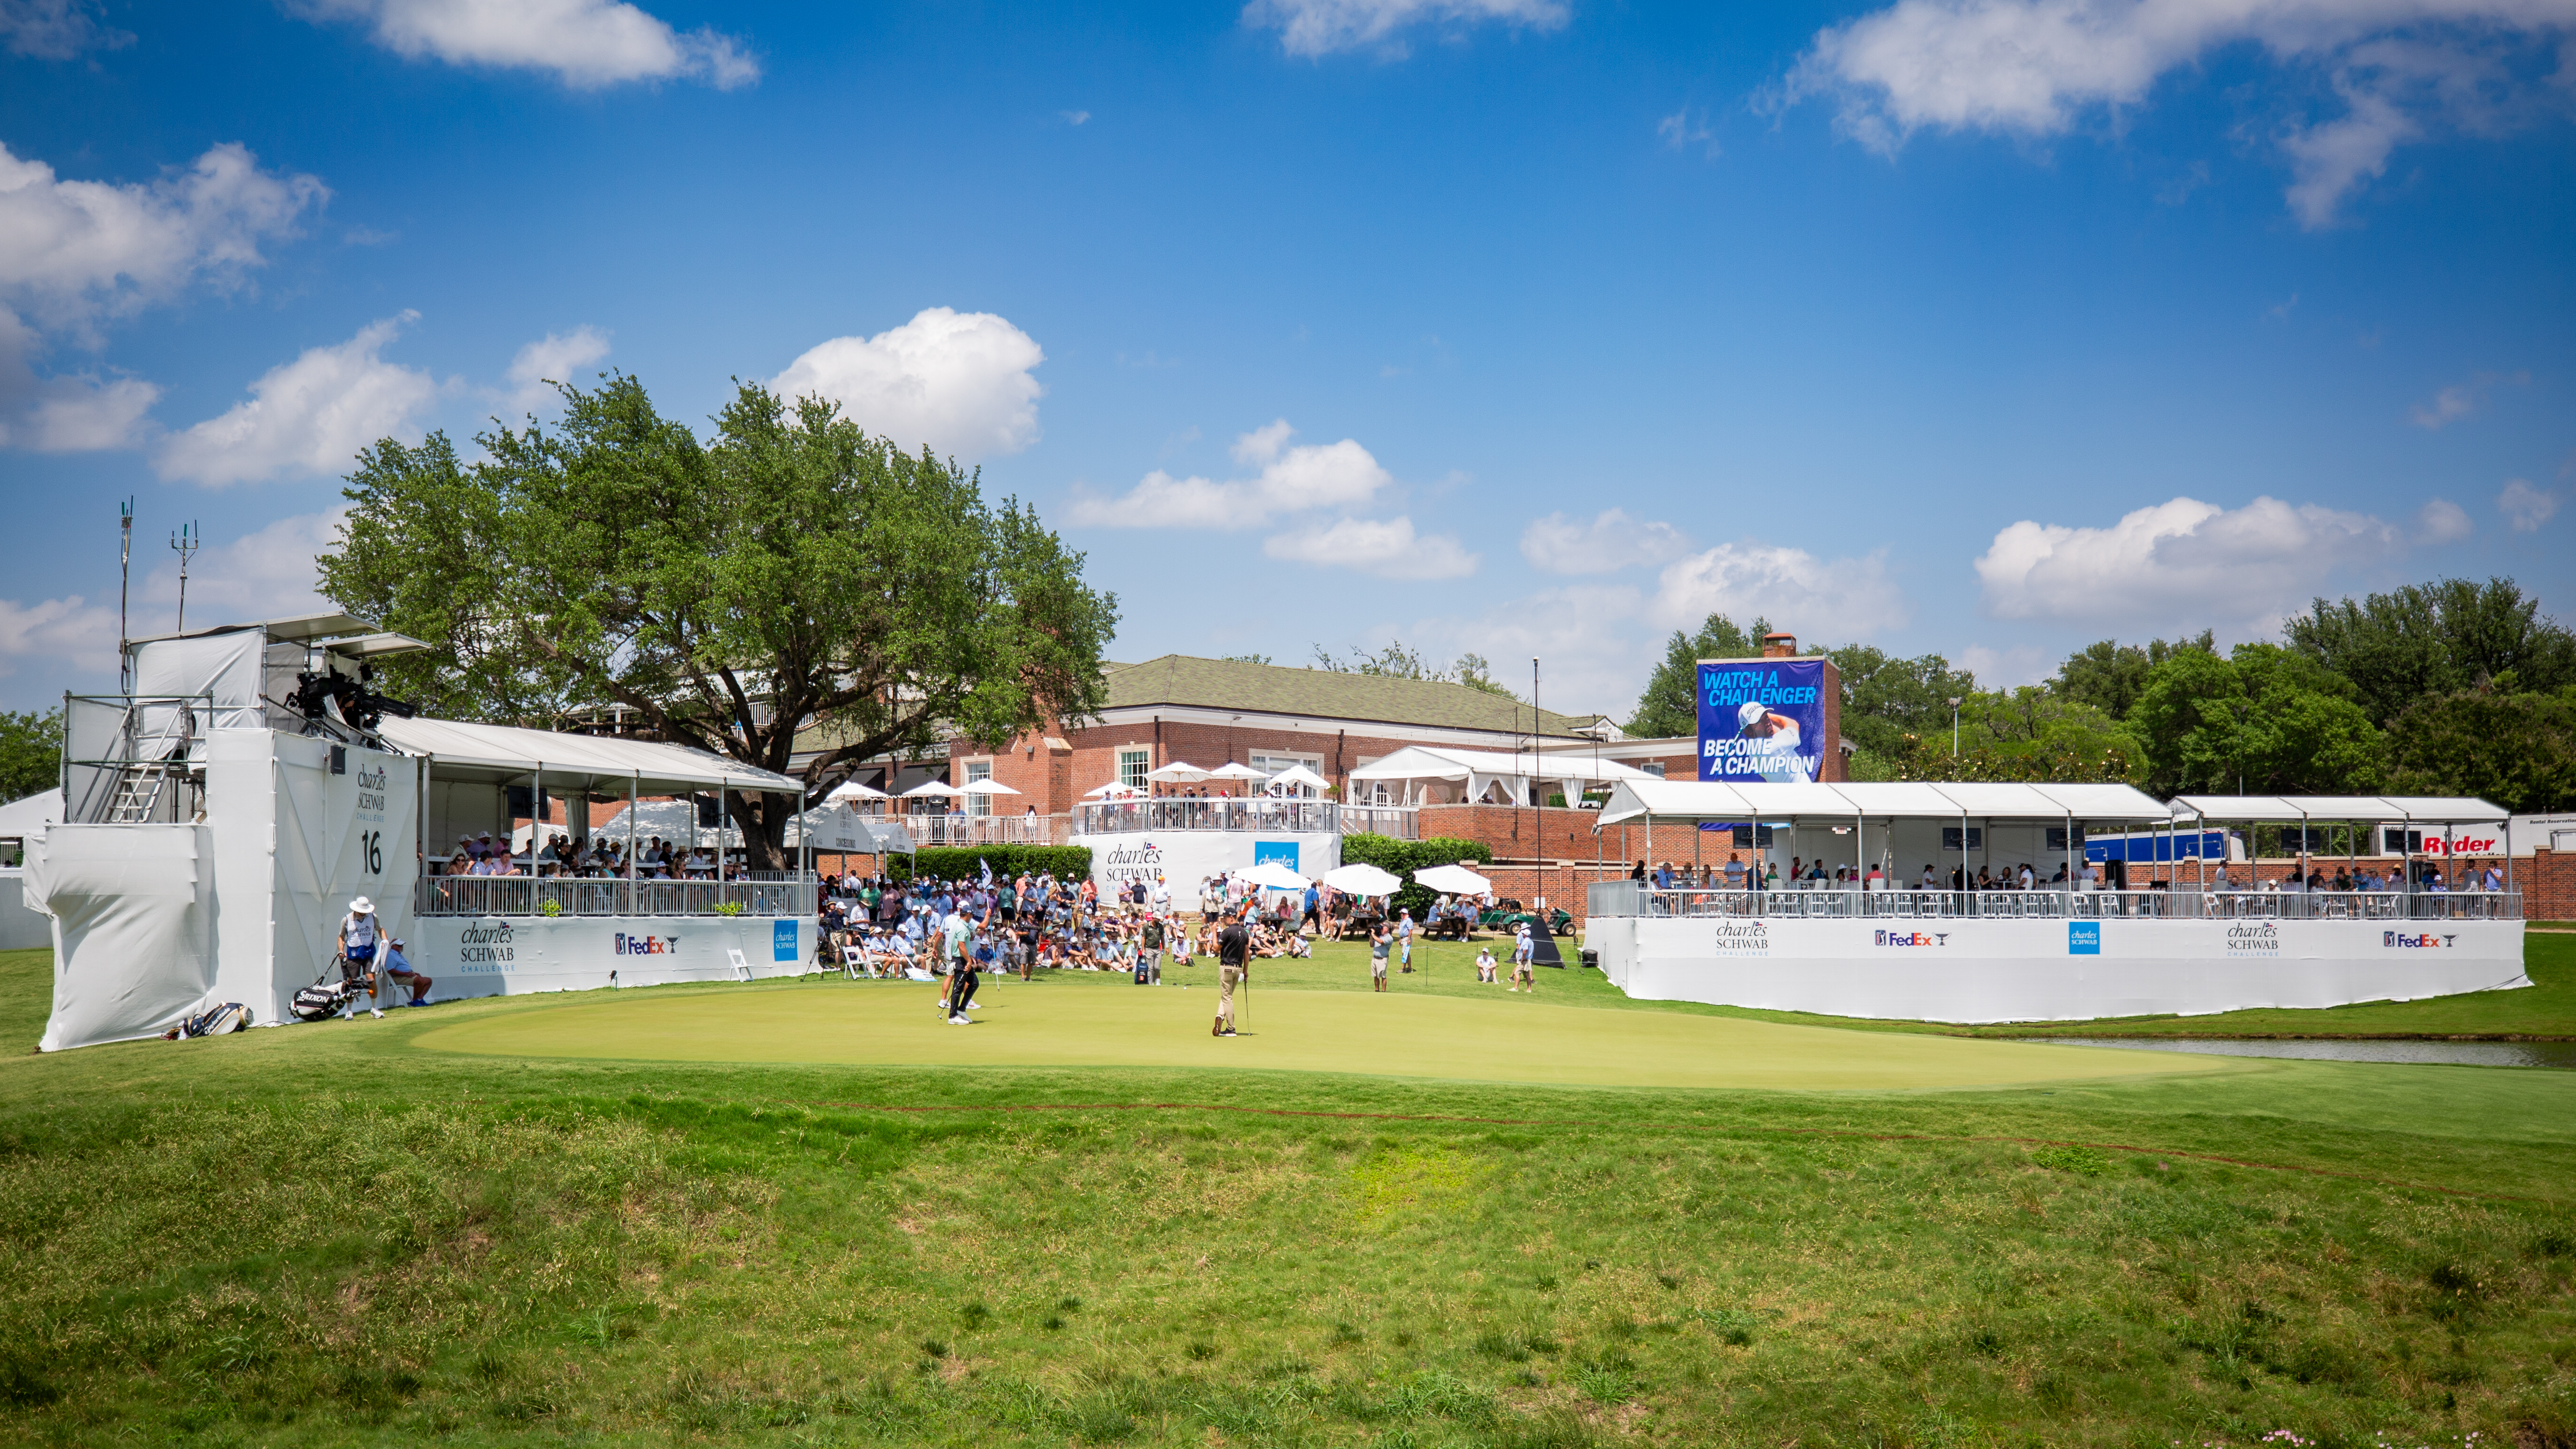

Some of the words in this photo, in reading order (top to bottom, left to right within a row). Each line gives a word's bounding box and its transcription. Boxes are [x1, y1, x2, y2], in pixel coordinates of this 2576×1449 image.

[1704, 671, 1763, 689] WATCH
[1766, 670, 1779, 687] A
[1708, 686, 1816, 707] CHALLENGER
[1703, 738, 1772, 758] BECOME
[1709, 757, 1723, 776] A
[1725, 755, 1815, 775] CHAMPION
[358, 763, 386, 791] charles
[362, 830, 381, 875] 16
[1108, 841, 1162, 864] charles
[2423, 836, 2495, 856] Ryder
[461, 920, 514, 944] charles
[775, 931, 795, 941] charles
[1717, 921, 1767, 936] charles
[2071, 930, 2097, 939] charles
[2228, 922, 2278, 937] charles
[628, 936, 665, 955] FedEx
[1717, 939, 1768, 949] SCHWAB
[1890, 932, 1932, 946] FedEx
[2228, 940, 2278, 949] SCHWAB
[2398, 934, 2440, 948] FedEx
[461, 948, 514, 962] SCHWAB
[297, 991, 330, 1003] SRIXON
